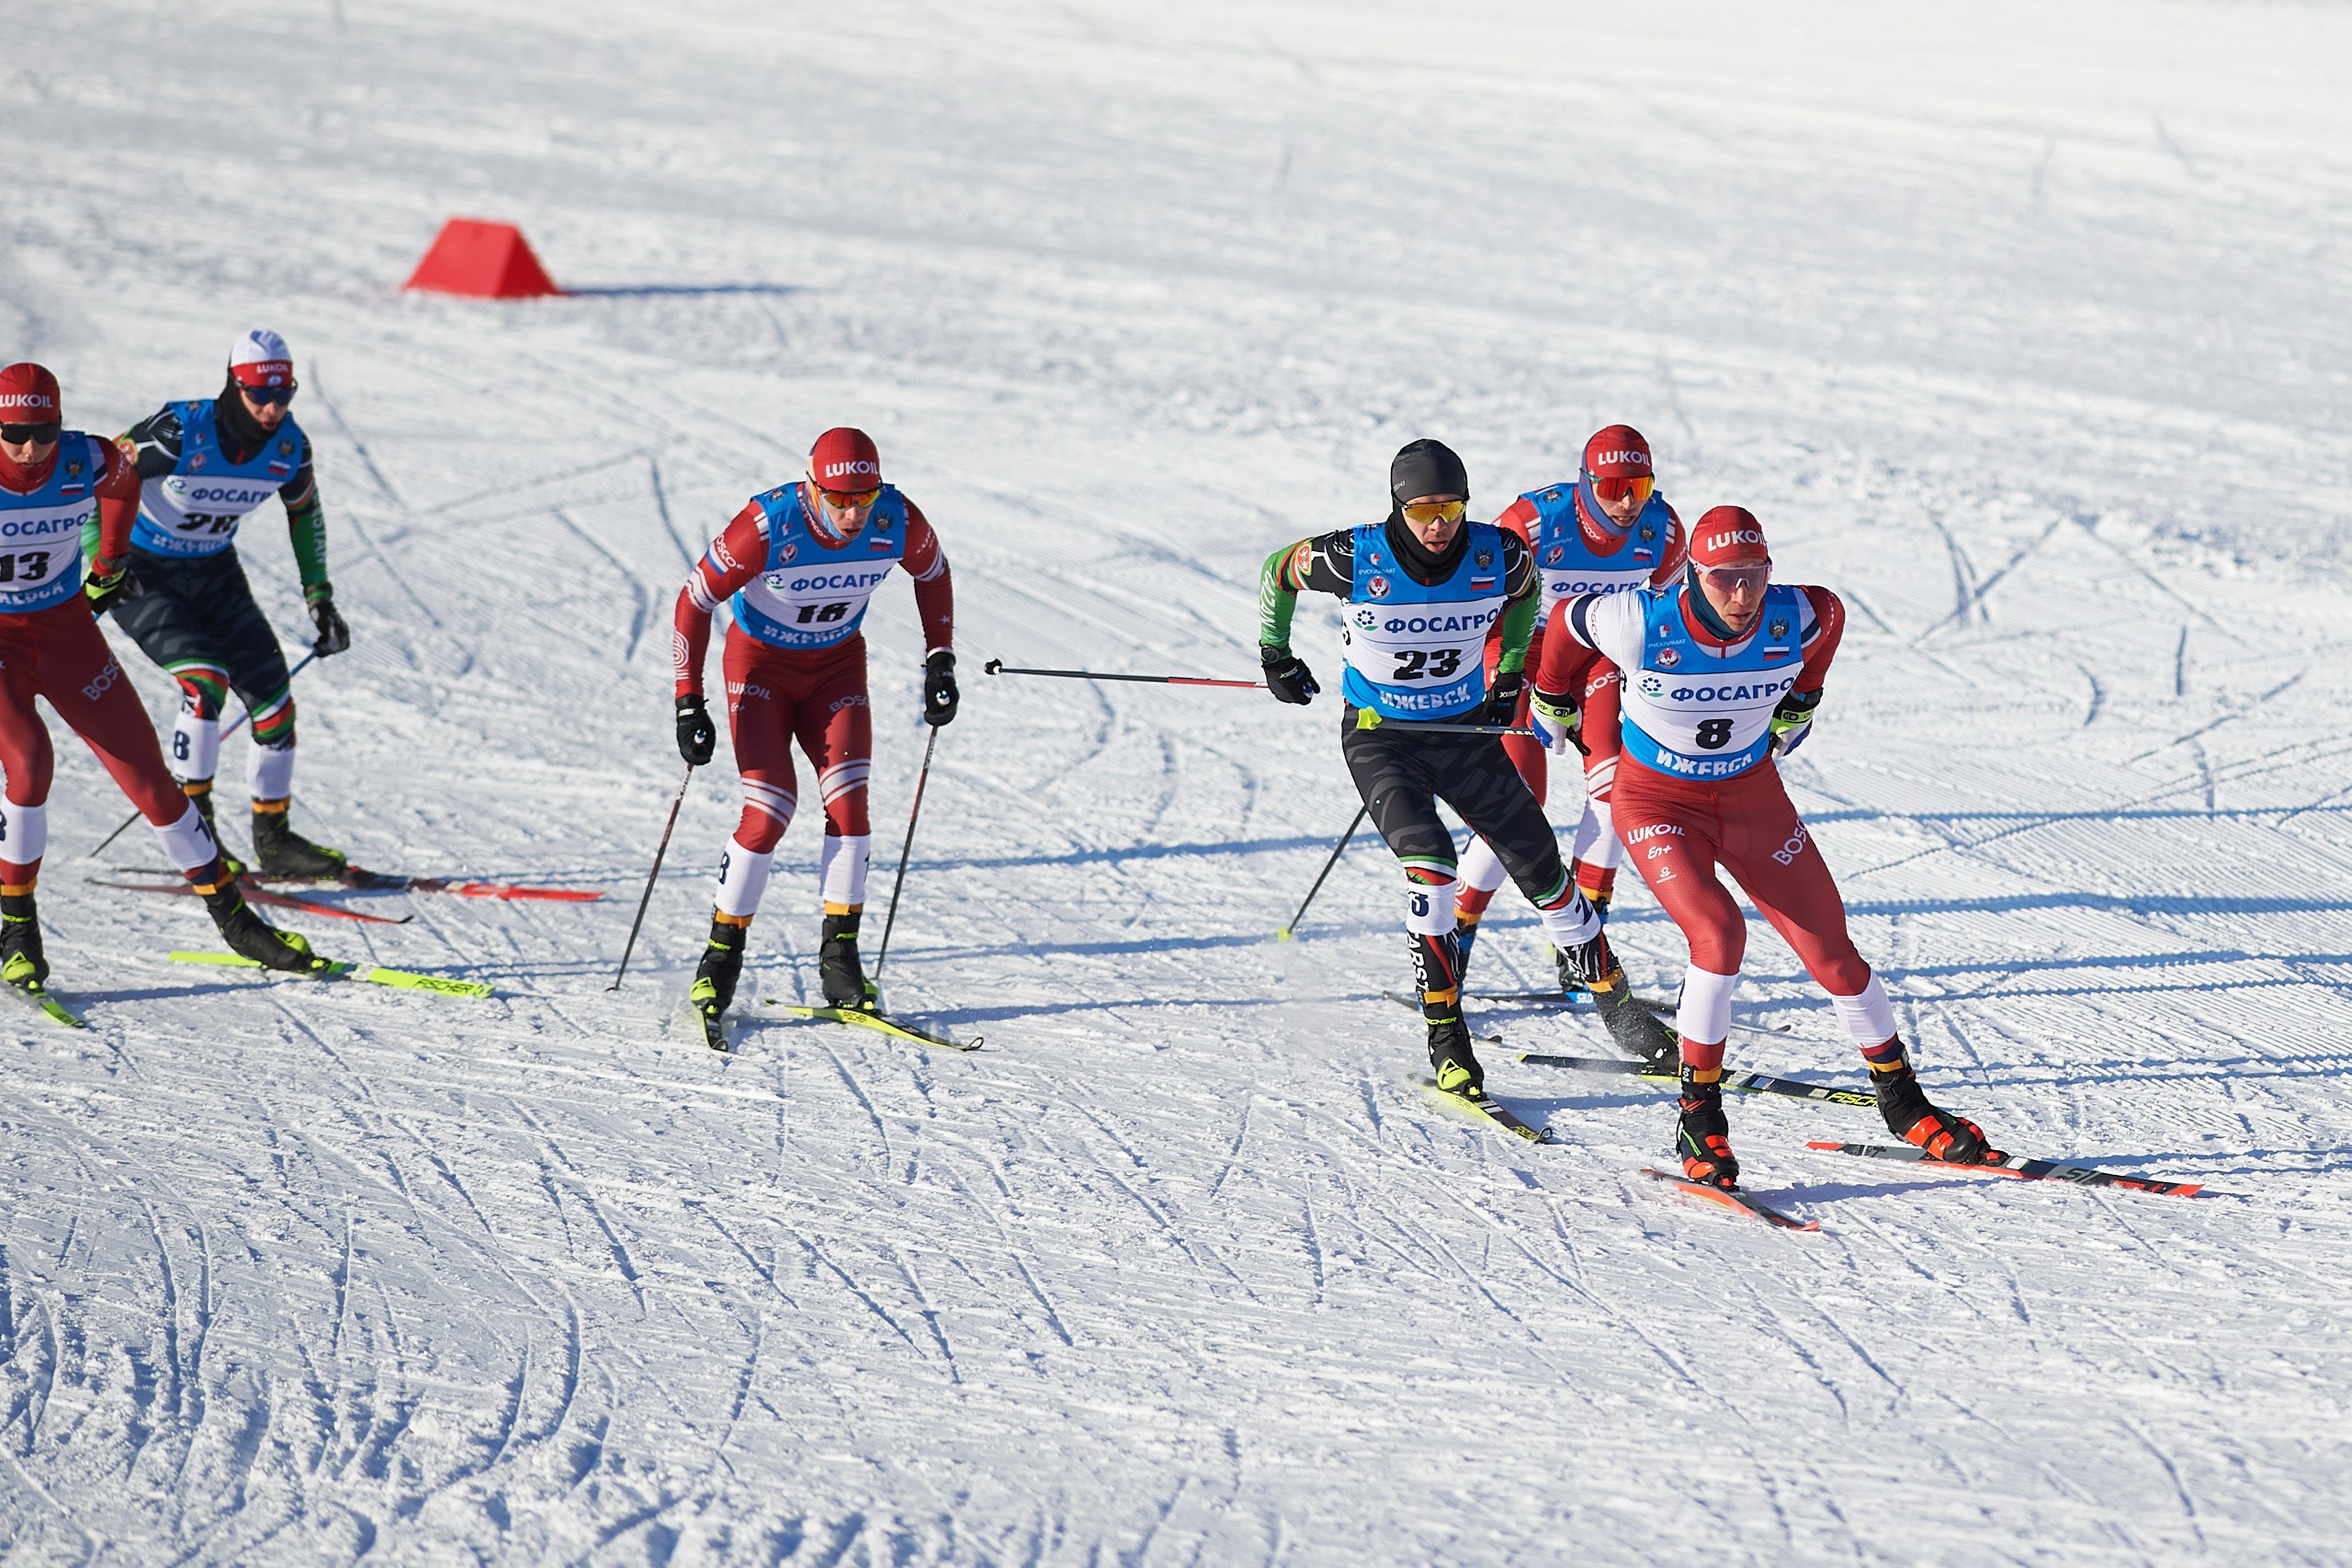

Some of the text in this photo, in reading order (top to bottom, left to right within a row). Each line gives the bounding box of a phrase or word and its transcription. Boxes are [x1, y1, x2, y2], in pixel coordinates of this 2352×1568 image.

[256, 364, 289, 374] LUKOIL
[0, 394, 53, 408] LUKOIL
[825, 460, 878, 478] LUKOIL
[1598, 450, 1650, 467] LUKOIL
[0, 513, 89, 536] ОСАГРО
[0, 551, 51, 582] 13
[1384, 607, 1498, 634] ФОСАГРО
[1393, 649, 1463, 681] 23
[728, 681, 771, 700] LUKOIL
[1670, 677, 1795, 702] ФОСАГРО
[1695, 718, 1735, 750] 8
[1627, 824, 1685, 845] LUKOIL
[842, 1010, 868, 1023] FISCHER
